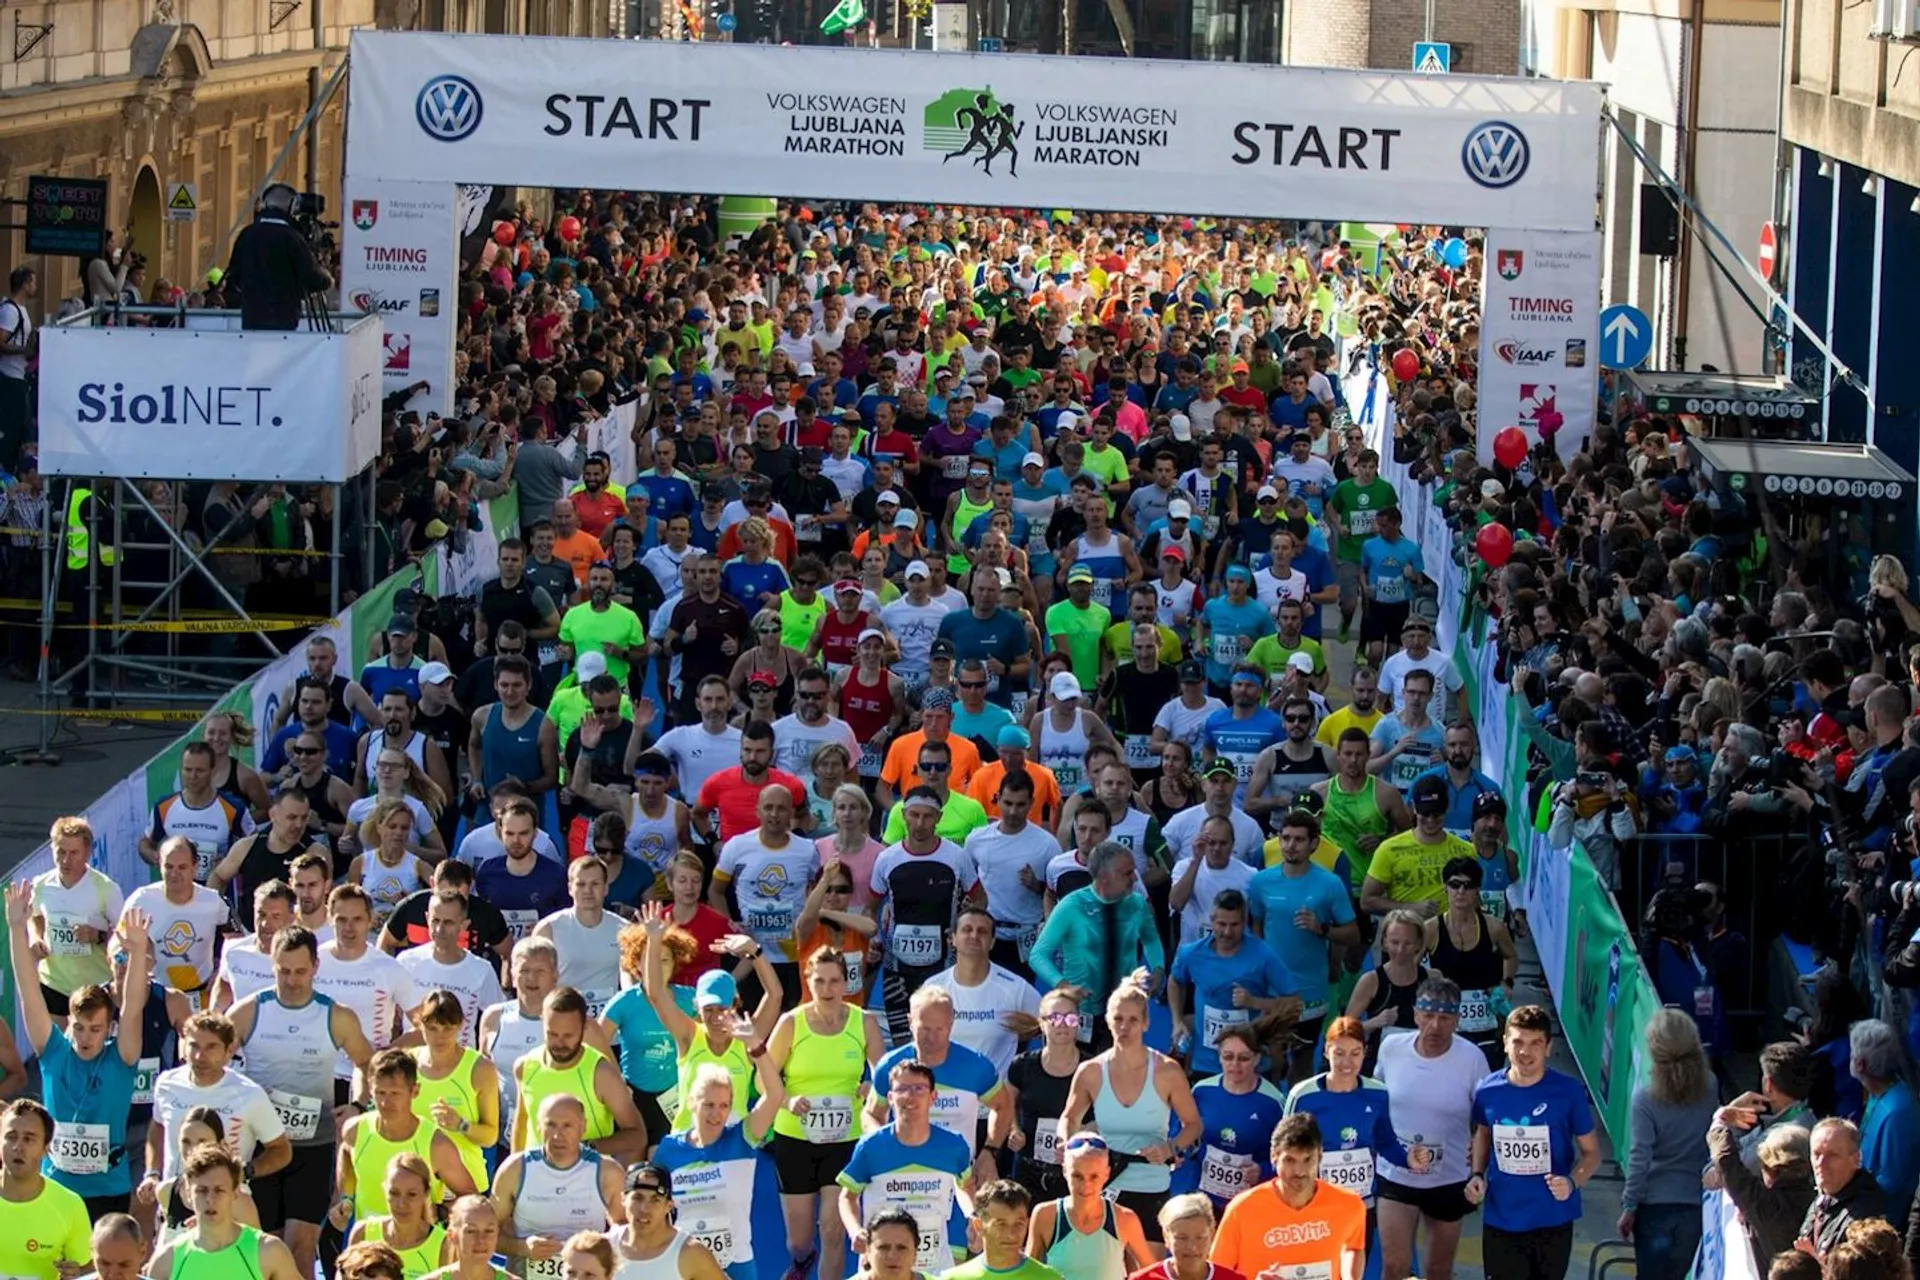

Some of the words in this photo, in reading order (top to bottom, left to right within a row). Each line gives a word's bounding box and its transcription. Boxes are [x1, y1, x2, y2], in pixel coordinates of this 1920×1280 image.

[767, 92, 906, 115] VOLKSWAGEN
[544, 93, 711, 141] START
[1036, 103, 1177, 126] VOLKSWAGEN
[791, 115, 906, 136] LJUBLJANA
[1036, 125, 1168, 147] LJUBLJANSKI
[784, 136, 904, 156] MARATHON
[1231, 121, 1401, 171] START
[1034, 146, 1140, 166] MARATON
[364, 246, 427, 263] TIMING
[366, 263, 427, 272] LJUBLJANA
[1509, 297, 1573, 314] TIMING
[1511, 314, 1573, 323] LJUBLJANA
[1518, 350, 1556, 361] IAAF
[184, 620, 219, 632] VALINA
[857, 756, 876, 765] 09
[171, 822, 218, 831] KOLEKTOR
[754, 915, 787, 928] 11963
[52, 928, 79, 943] 790
[901, 939, 933, 953] 7197
[809, 1112, 845, 1128] 7117
[61, 1140, 99, 1158] 5306
[1503, 1141, 1541, 1159] 3096
[1209, 1164, 1243, 1186] 5969
[1330, 1165, 1366, 1185] 5968
[886, 1179, 942, 1194] ebmpapst
[1265, 1221, 1330, 1247] CEDEVITA
